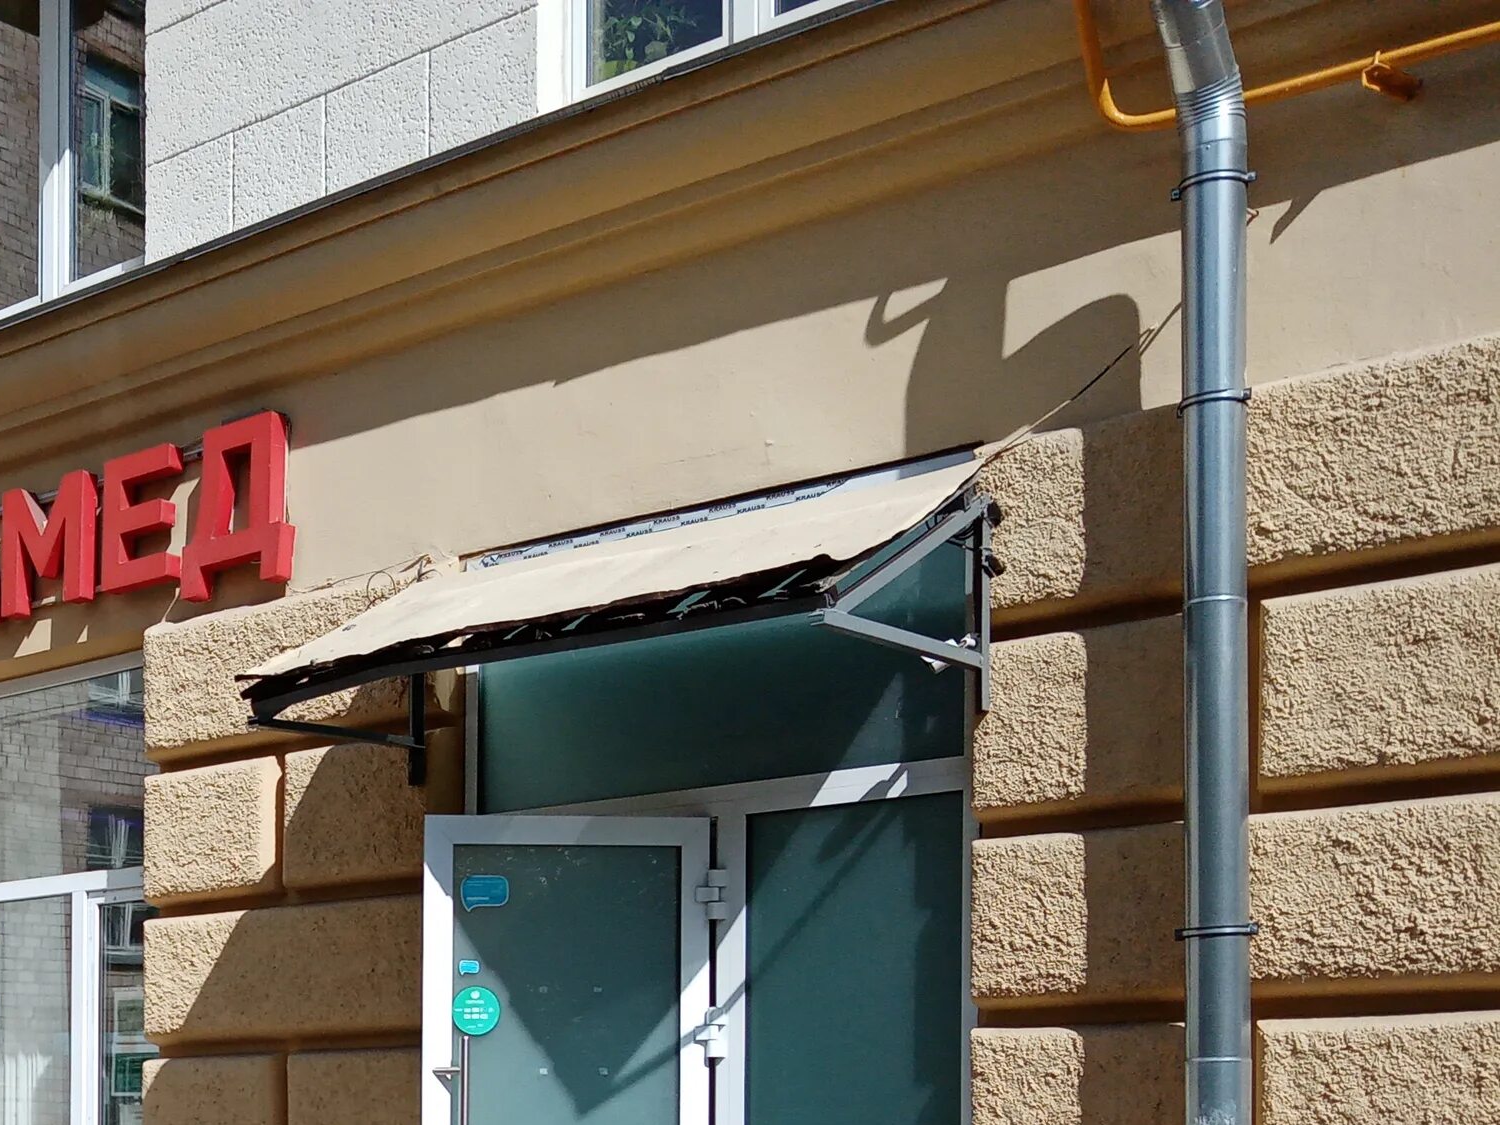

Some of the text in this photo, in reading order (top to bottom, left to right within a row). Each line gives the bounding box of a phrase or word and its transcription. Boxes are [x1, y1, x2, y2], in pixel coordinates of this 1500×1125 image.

[600, 527, 626, 537] KRAUSS
[653, 515, 680, 525] KRAUSS
[708, 503, 737, 513] KRAUSS
[766, 490, 795, 501] KRAUSS
[626, 528, 653, 538] KRAUSS
[680, 517, 708, 527] KRAUSS
[737, 504, 765, 514] KRAUSS
